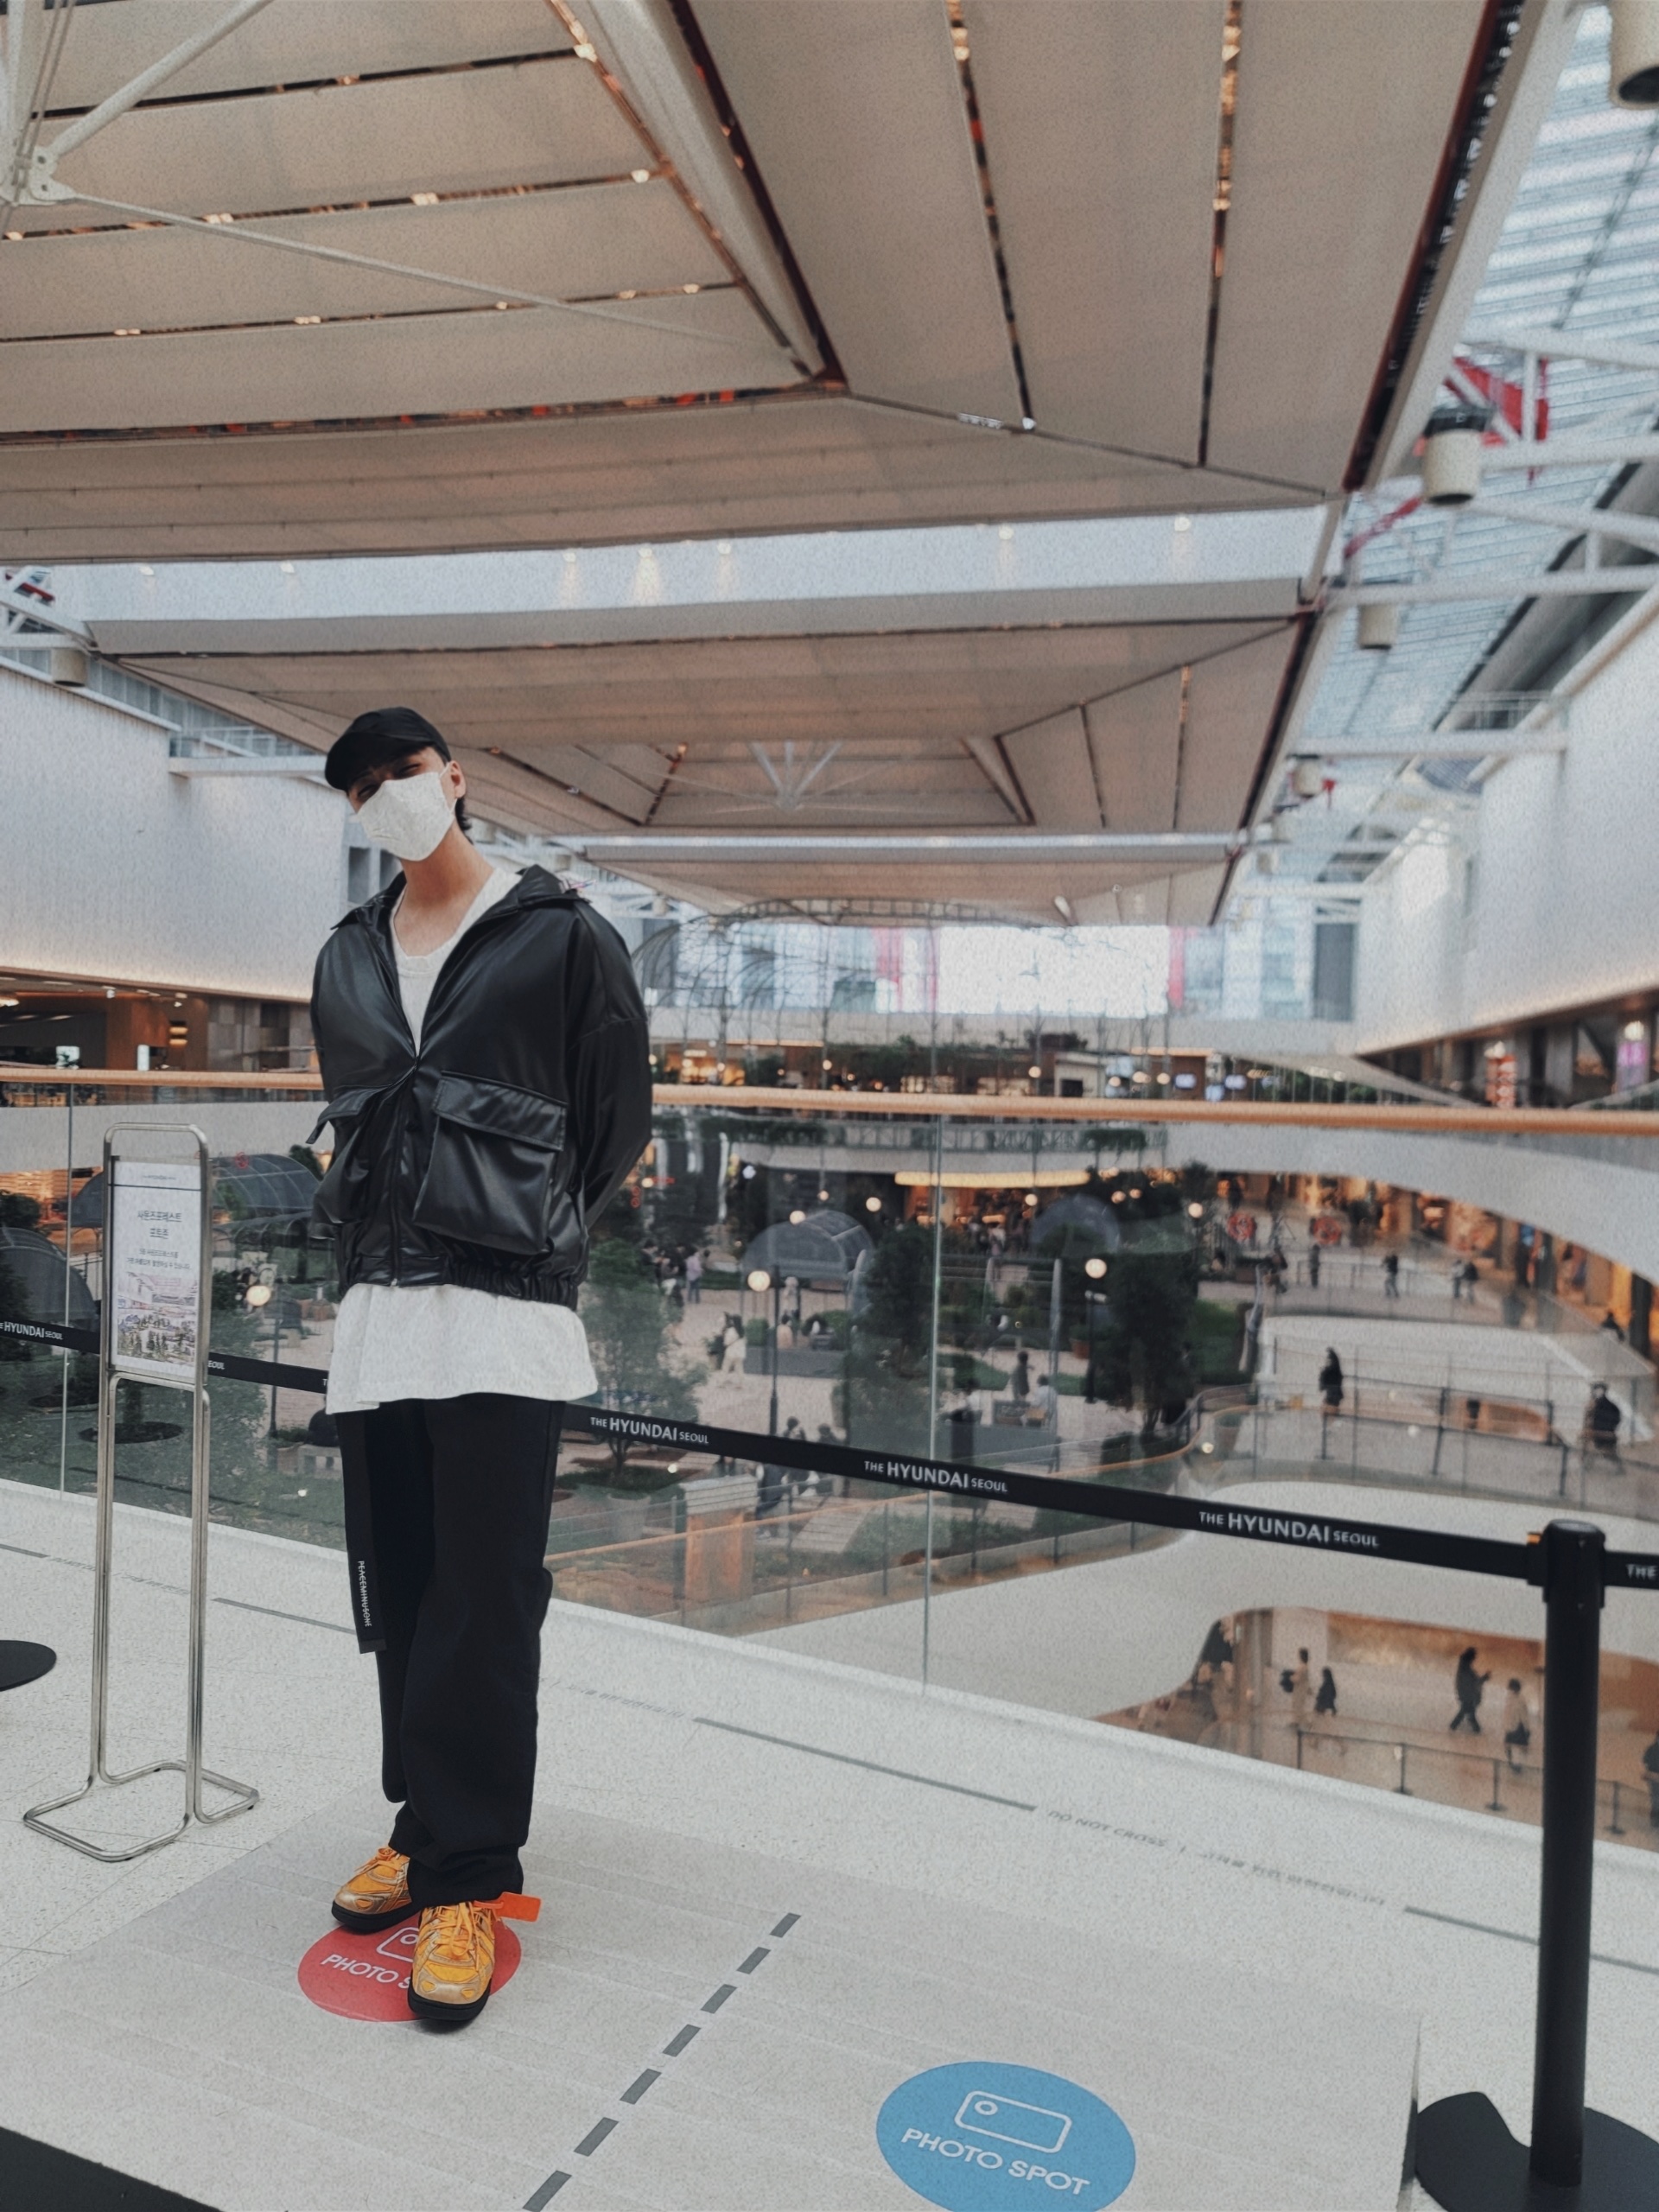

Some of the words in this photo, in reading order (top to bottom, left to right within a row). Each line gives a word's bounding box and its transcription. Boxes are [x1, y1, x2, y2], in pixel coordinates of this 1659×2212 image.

[4, 1321, 45, 1338] HYUNDAI
[45, 1331, 64, 1340] SEOUL
[208, 1360, 226, 1370] EOUL
[590, 1416, 607, 1427] THE
[609, 1417, 677, 1440] HYUNDAI
[679, 1431, 709, 1444] SEOUL
[864, 1460, 884, 1472] THE
[887, 1461, 969, 1489] HYUNDAI
[970, 1478, 1008, 1492] SEOUL
[1199, 1511, 1224, 1526] THE
[1228, 1512, 1330, 1544] HYUNDAI
[1332, 1530, 1380, 1549] SEOUL
[1625, 1563, 1658, 1580] THE
[357, 1560, 372, 1627] PEACEMINUSONE
[321, 1954, 398, 1983] PHOTO
[900, 2127, 1003, 2170] PHOTO
[1007, 2159, 1090, 2196] SPOT
